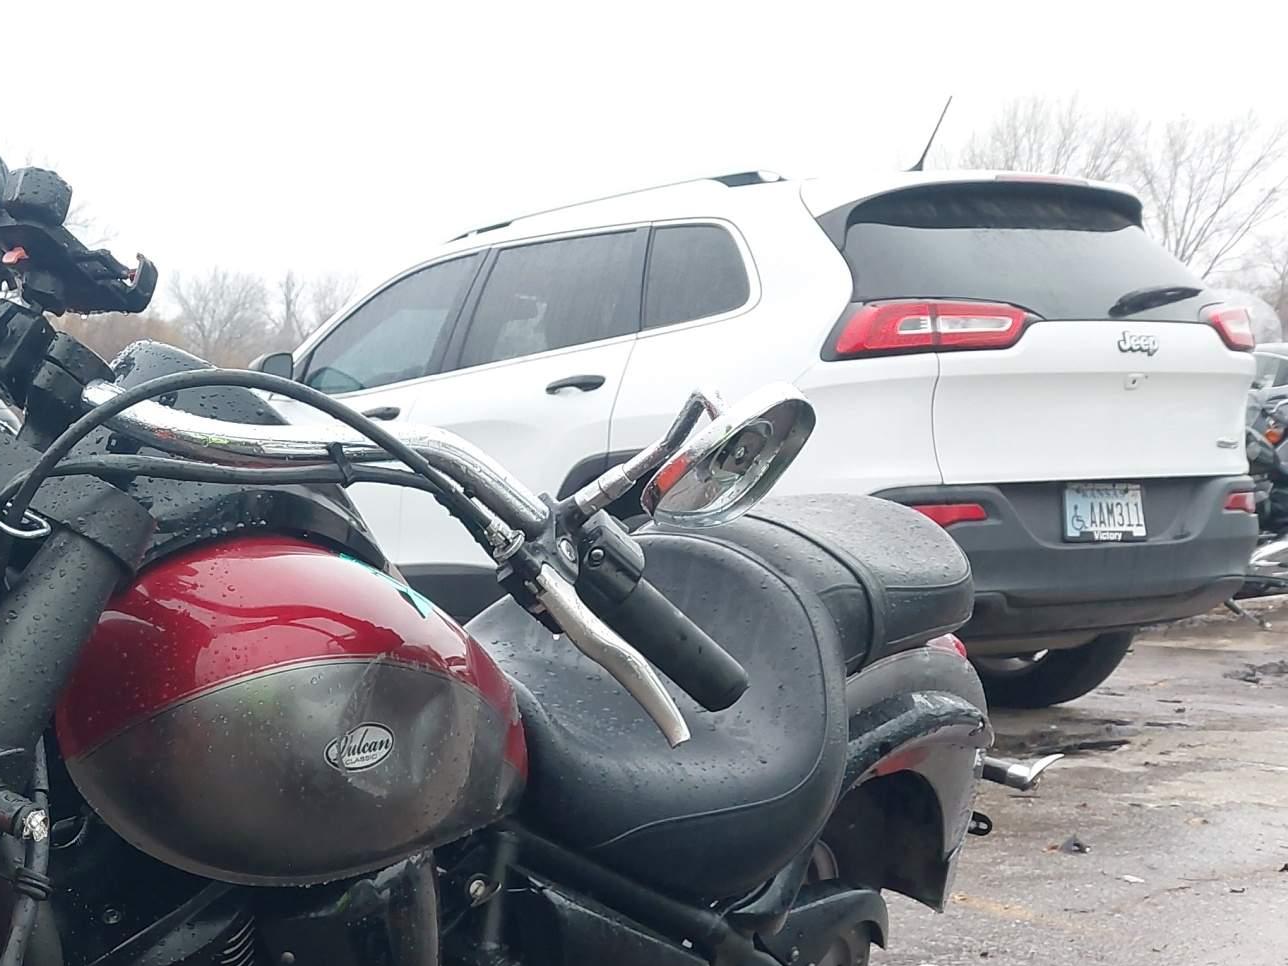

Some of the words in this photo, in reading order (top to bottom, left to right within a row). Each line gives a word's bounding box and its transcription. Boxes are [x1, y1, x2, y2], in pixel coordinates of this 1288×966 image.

[1117, 330, 1159, 357] Jeep
[1090, 501, 1144, 528] AAM311
[1093, 531, 1122, 541] Victory
[338, 727, 390, 757] Vulcan
